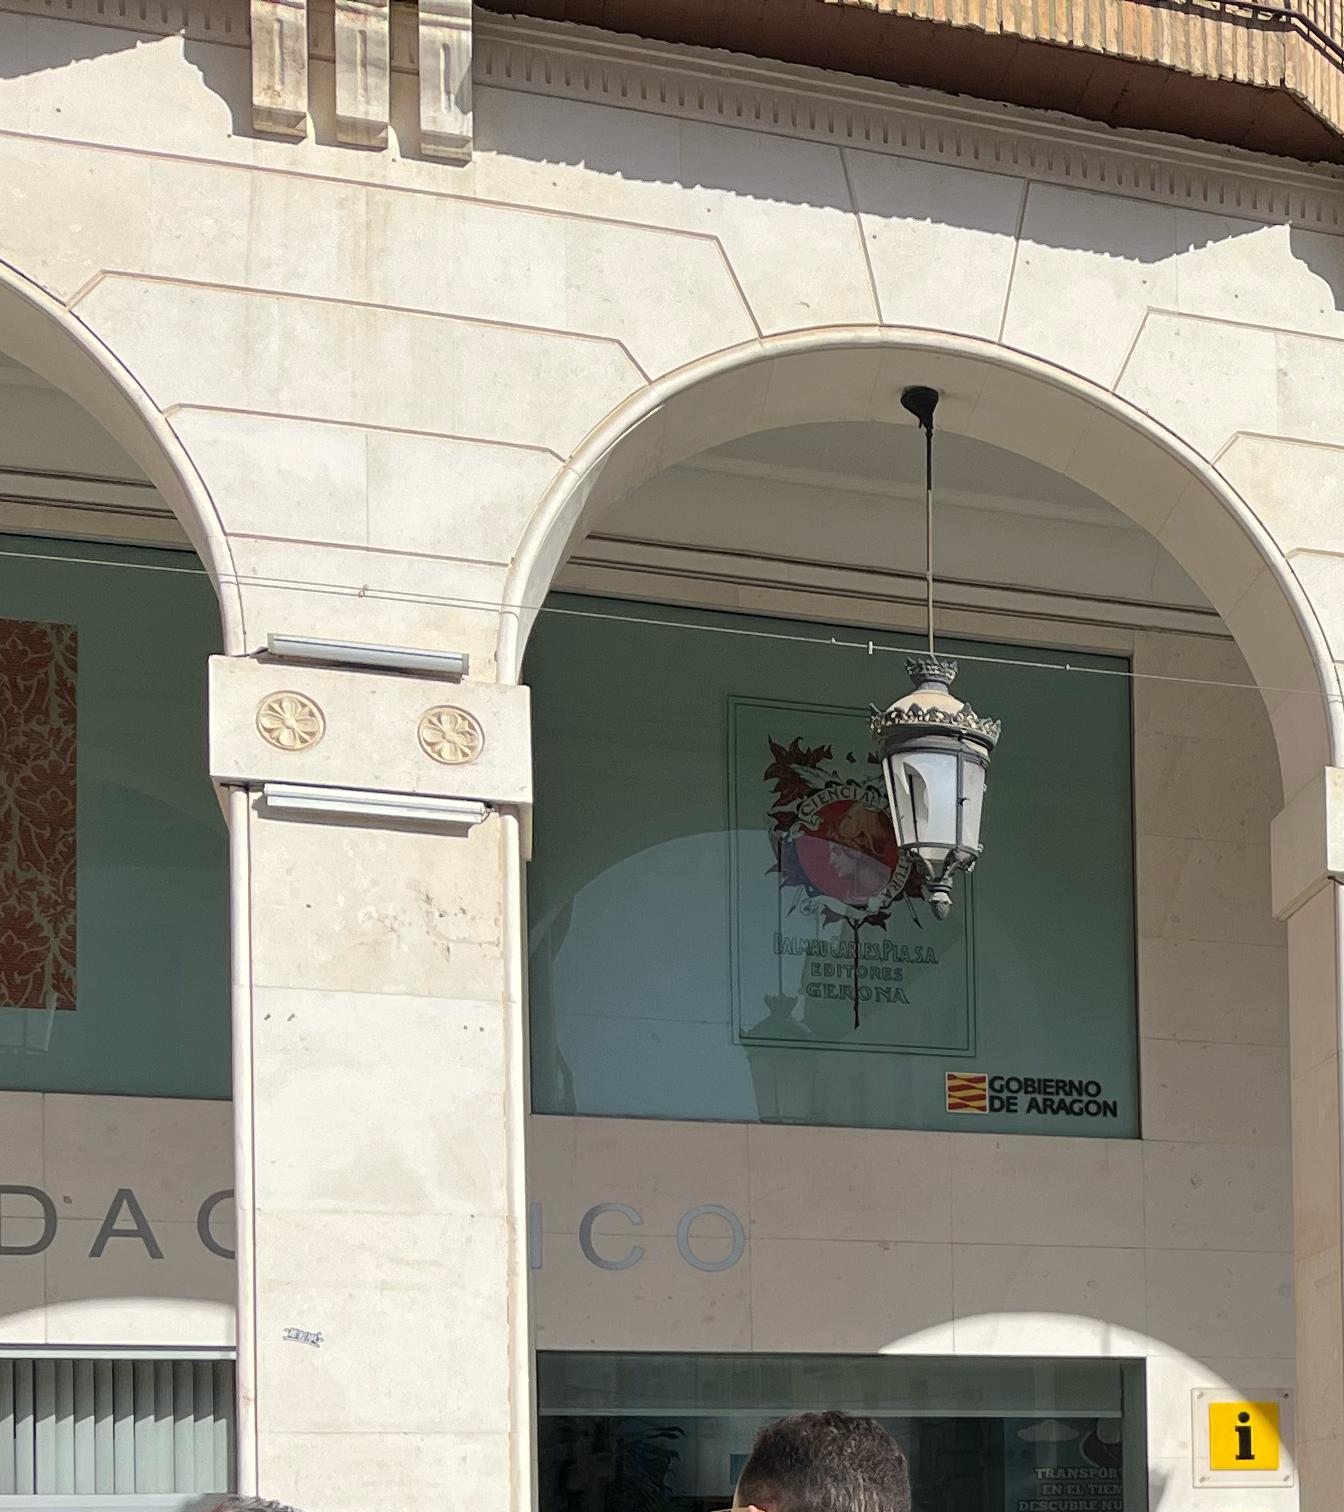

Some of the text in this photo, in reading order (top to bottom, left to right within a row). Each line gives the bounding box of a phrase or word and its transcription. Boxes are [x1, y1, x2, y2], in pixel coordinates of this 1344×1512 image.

[810, 962, 903, 982] EDITORES
[806, 982, 910, 1005] GERONA
[989, 1076, 1102, 1098] GOBIERNO
[989, 1096, 1018, 1114] DE
[1035, 1465, 1122, 1480] TRANSPÓR
[1041, 1484, 1063, 1495] EN
[1066, 1484, 1086, 1495] EL
[1018, 1501, 1099, 1512] DESCUBRE
